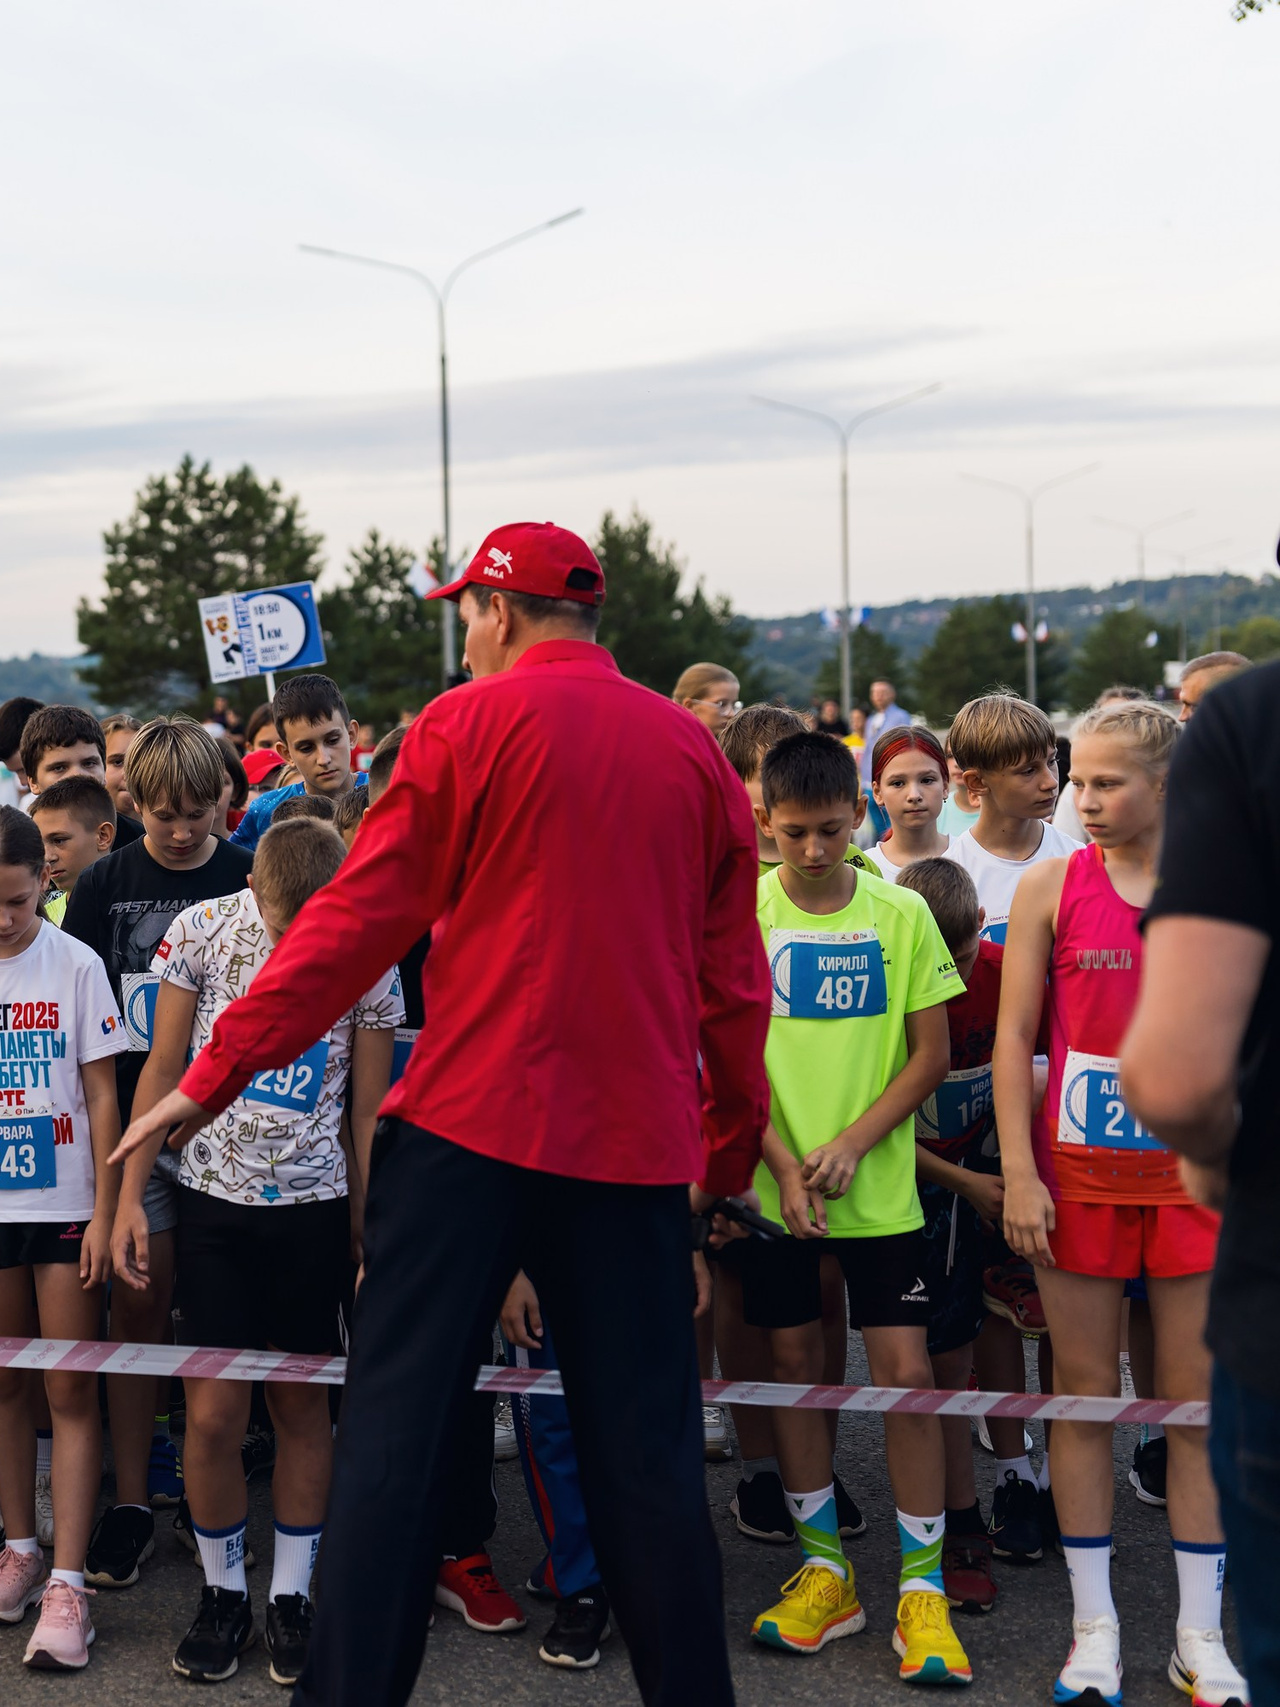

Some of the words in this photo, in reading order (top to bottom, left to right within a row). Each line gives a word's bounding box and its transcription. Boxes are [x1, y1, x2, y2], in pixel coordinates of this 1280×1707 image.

[108, 901, 154, 915] FIRST
[818, 955, 868, 971] КИРИЛЛ
[815, 975, 870, 1010] 487
[248, 1062, 314, 1102] 292
[971, 1076, 993, 1096] ИВА
